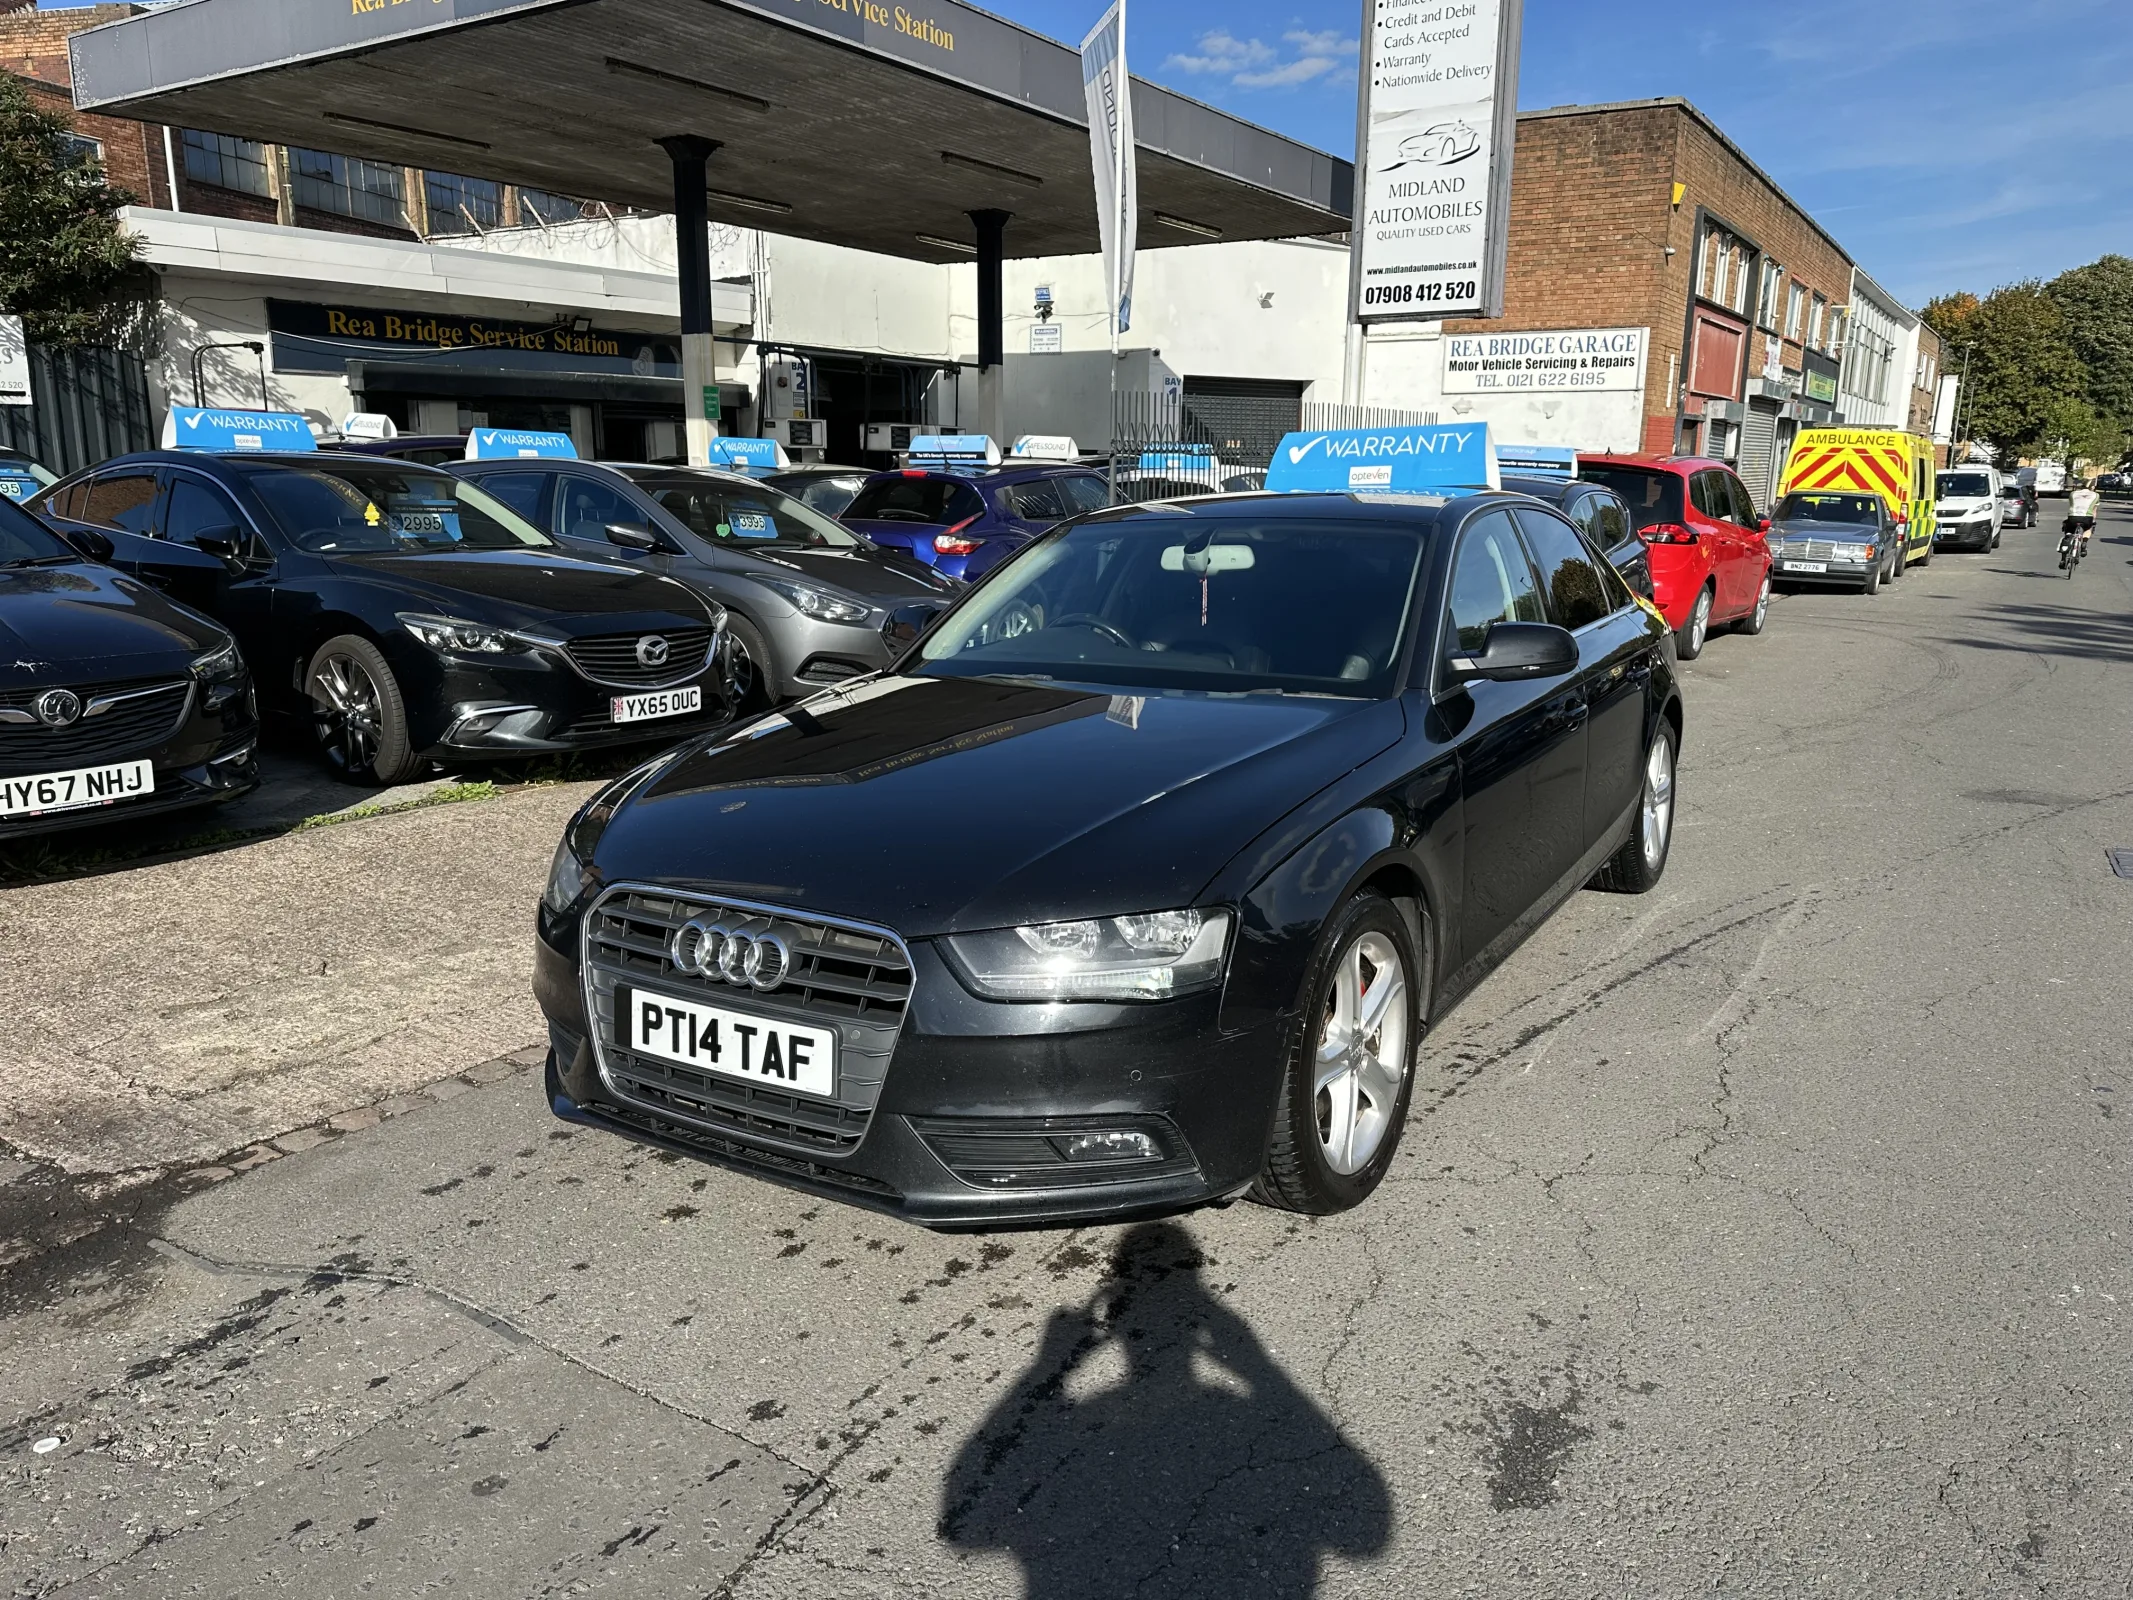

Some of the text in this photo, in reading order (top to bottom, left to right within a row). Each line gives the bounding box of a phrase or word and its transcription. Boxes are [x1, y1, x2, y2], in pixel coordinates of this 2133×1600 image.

[818, 0, 955, 51] rvice Station
[1385, 4, 1476, 29] Credit and Debit
[1384, 24, 1470, 49] Cards Accepted
[1383, 53, 1431, 69] Warranty
[1382, 64, 1493, 89] Nationwide Delivery
[1388, 177, 1465, 198] MIDLAND
[1368, 200, 1483, 225] AUTOMOBILES
[1376, 224, 1471, 241] QUALITY USED CARS
[1366, 260, 1477, 276] www.midlandautomobiles.co.uk
[1365, 281, 1476, 305] 07908 412 520
[327, 310, 620, 356] Rea Bridge Service Station
[1450, 334, 1637, 357] REA BRIDGE GARAGE
[1448, 355, 1635, 372] Motor Vehicle Servicing & Repairs
[796, 373, 805, 390] 2
[1164, 377, 1181, 386] BAY
[1475, 372, 1606, 388] TEL. 0121 622 6195
[1169, 387, 1177, 404] 1
[207, 414, 300, 433] WARRANTY
[498, 433, 565, 448] WARRANTY
[725, 442, 771, 454] WARRANTY
[1325, 431, 1472, 458] WARRANTY
[1806, 434, 1896, 447] AMBULANCE
[1351, 468, 1390, 482] opteven
[626, 690, 698, 718] YX65 OUC
[86, 766, 142, 798] NHJ
[641, 1001, 815, 1081] PT14 TAF
